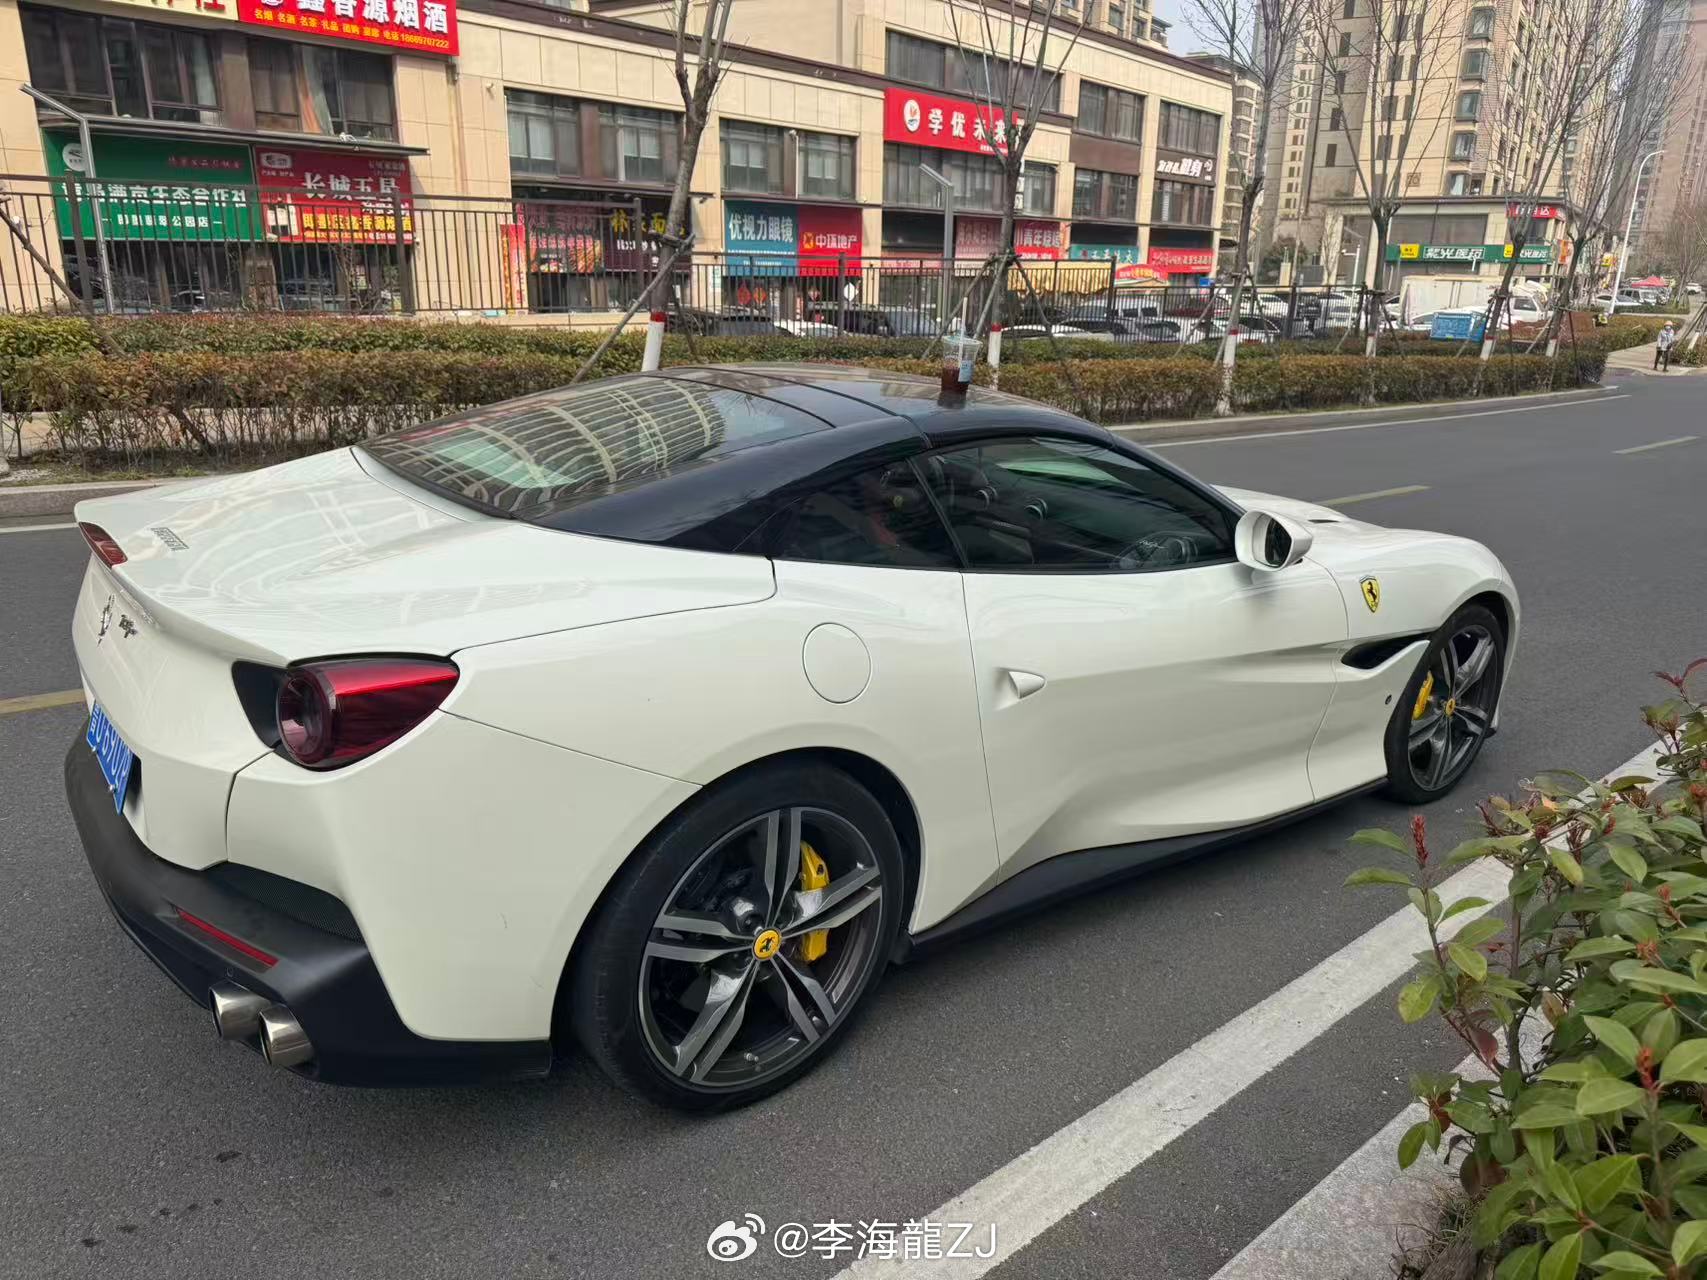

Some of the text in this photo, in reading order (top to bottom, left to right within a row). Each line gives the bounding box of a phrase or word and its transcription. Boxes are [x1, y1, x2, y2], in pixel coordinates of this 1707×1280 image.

[383, 30, 400, 41] 电话
[728, 211, 794, 244] 优视力眼镜
[814, 233, 858, 250] 中环地产
